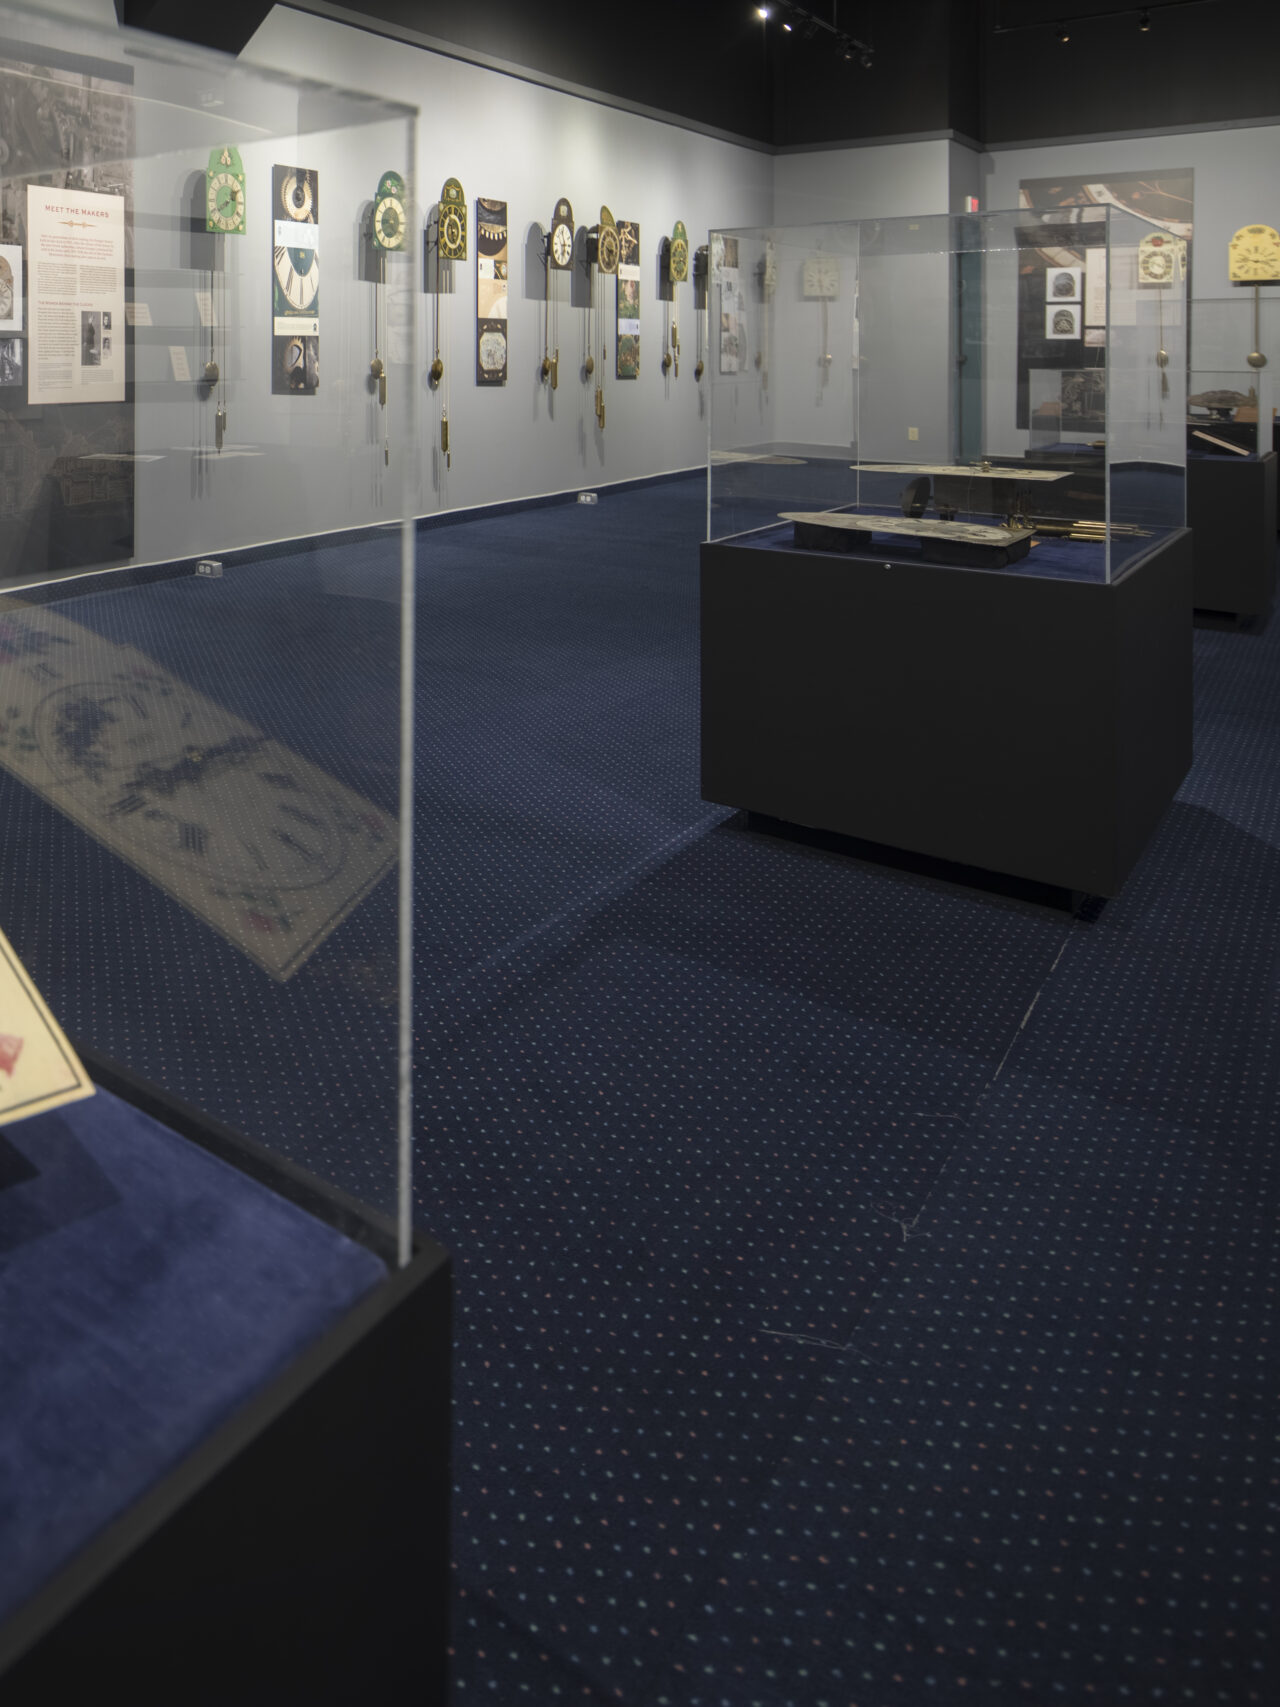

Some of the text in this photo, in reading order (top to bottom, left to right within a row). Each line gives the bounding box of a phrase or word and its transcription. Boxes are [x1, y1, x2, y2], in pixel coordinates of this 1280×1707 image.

[45, 204, 110, 218] MEET THE MAKERS
